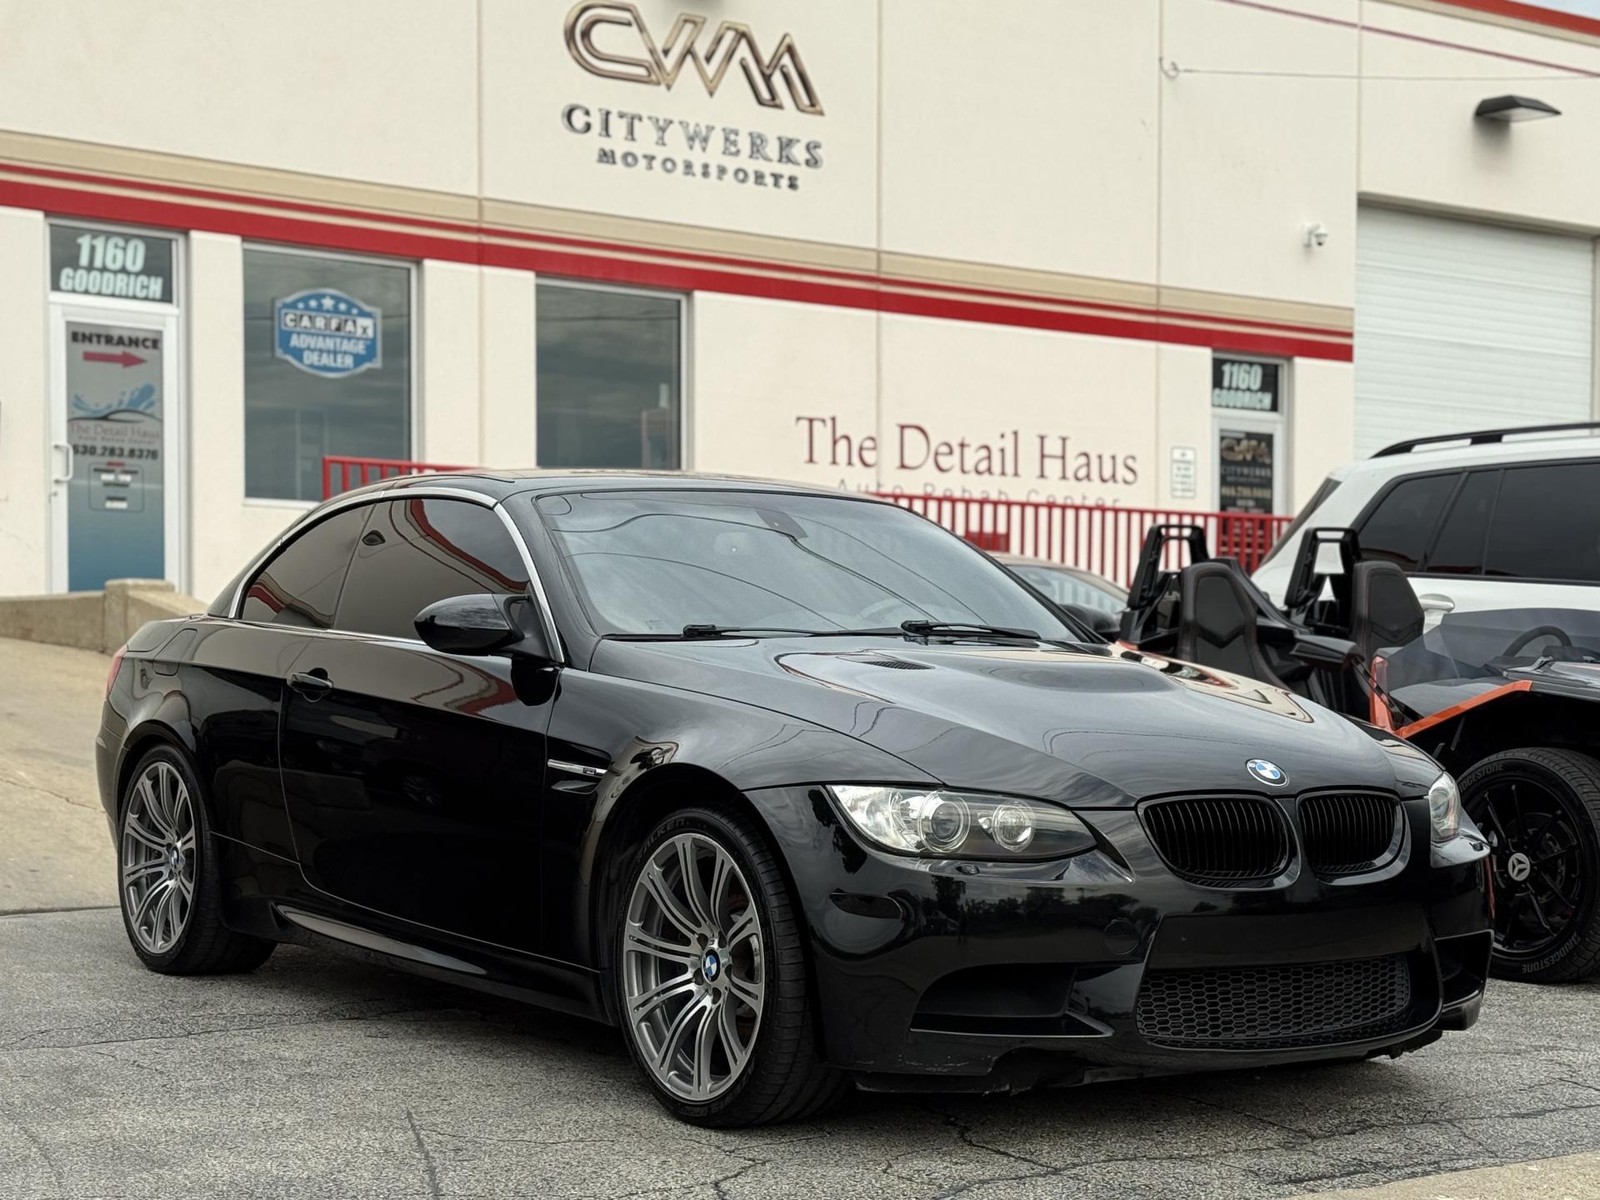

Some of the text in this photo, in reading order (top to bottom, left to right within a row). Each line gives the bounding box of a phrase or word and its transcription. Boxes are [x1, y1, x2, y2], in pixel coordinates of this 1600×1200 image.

[564, 0, 825, 117] CWM
[561, 103, 824, 169] CITYWERKS
[597, 147, 800, 191] MOTORSPORTS
[76, 233, 146, 273] 1160
[59, 267, 164, 300] GOODRICH
[70, 330, 161, 350] ENTRANCE
[283, 311, 375, 339] CARFAX
[289, 332, 368, 356] ADVANTAGE
[302, 349, 354, 369] DEALER
[1221, 362, 1263, 391] 1160
[795, 415, 1139, 487] The Detail Haus
[1458, 762, 1504, 794] IDGESTONE
